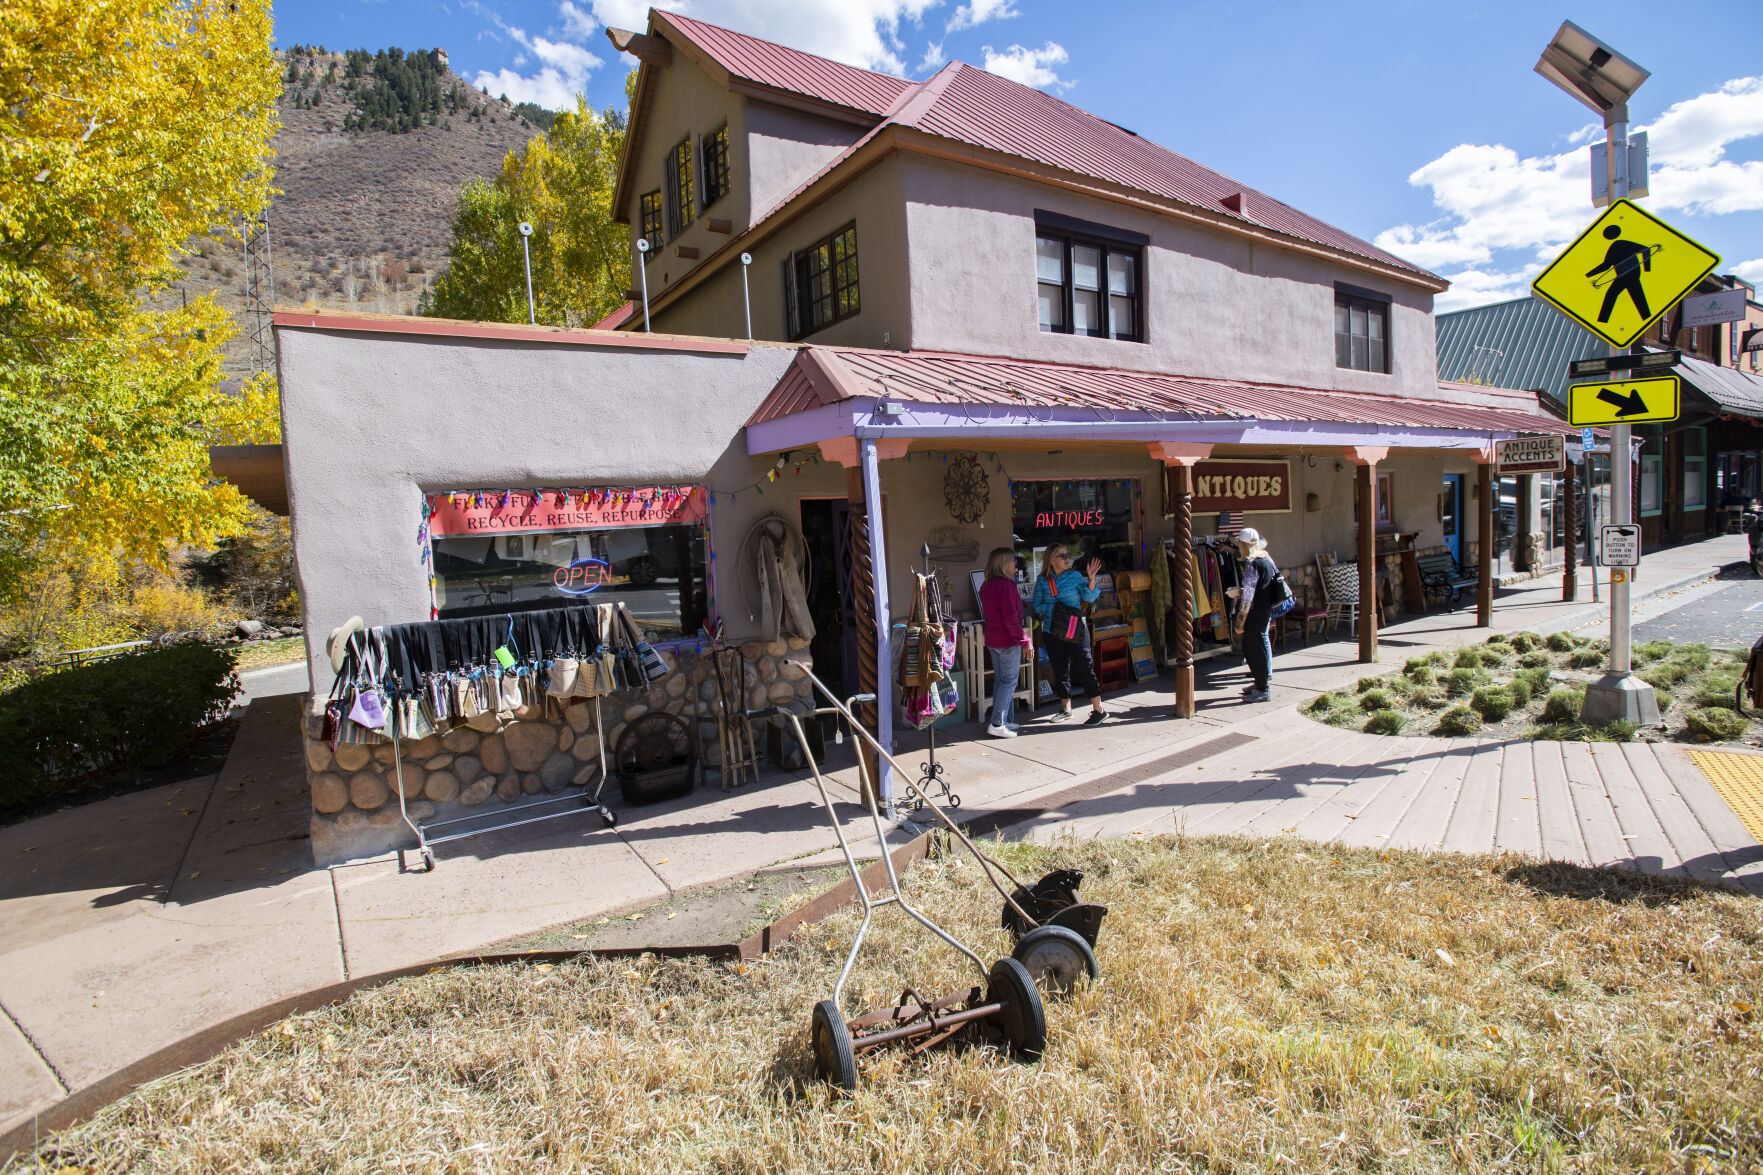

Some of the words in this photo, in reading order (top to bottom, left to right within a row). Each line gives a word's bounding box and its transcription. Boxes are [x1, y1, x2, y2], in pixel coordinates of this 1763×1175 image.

[1504, 439, 1555, 452] ANTIQUE
[1504, 450, 1555, 462] ACCENTS
[1191, 475, 1282, 499] NTIQUES
[511, 495, 539, 508] FUN
[467, 514, 542, 530] RECYCLE,
[547, 511, 598, 526] REUSE,
[602, 508, 682, 523] REPURPOSE
[1036, 509, 1103, 530] ANTIQUES
[553, 564, 613, 588] OPEN
